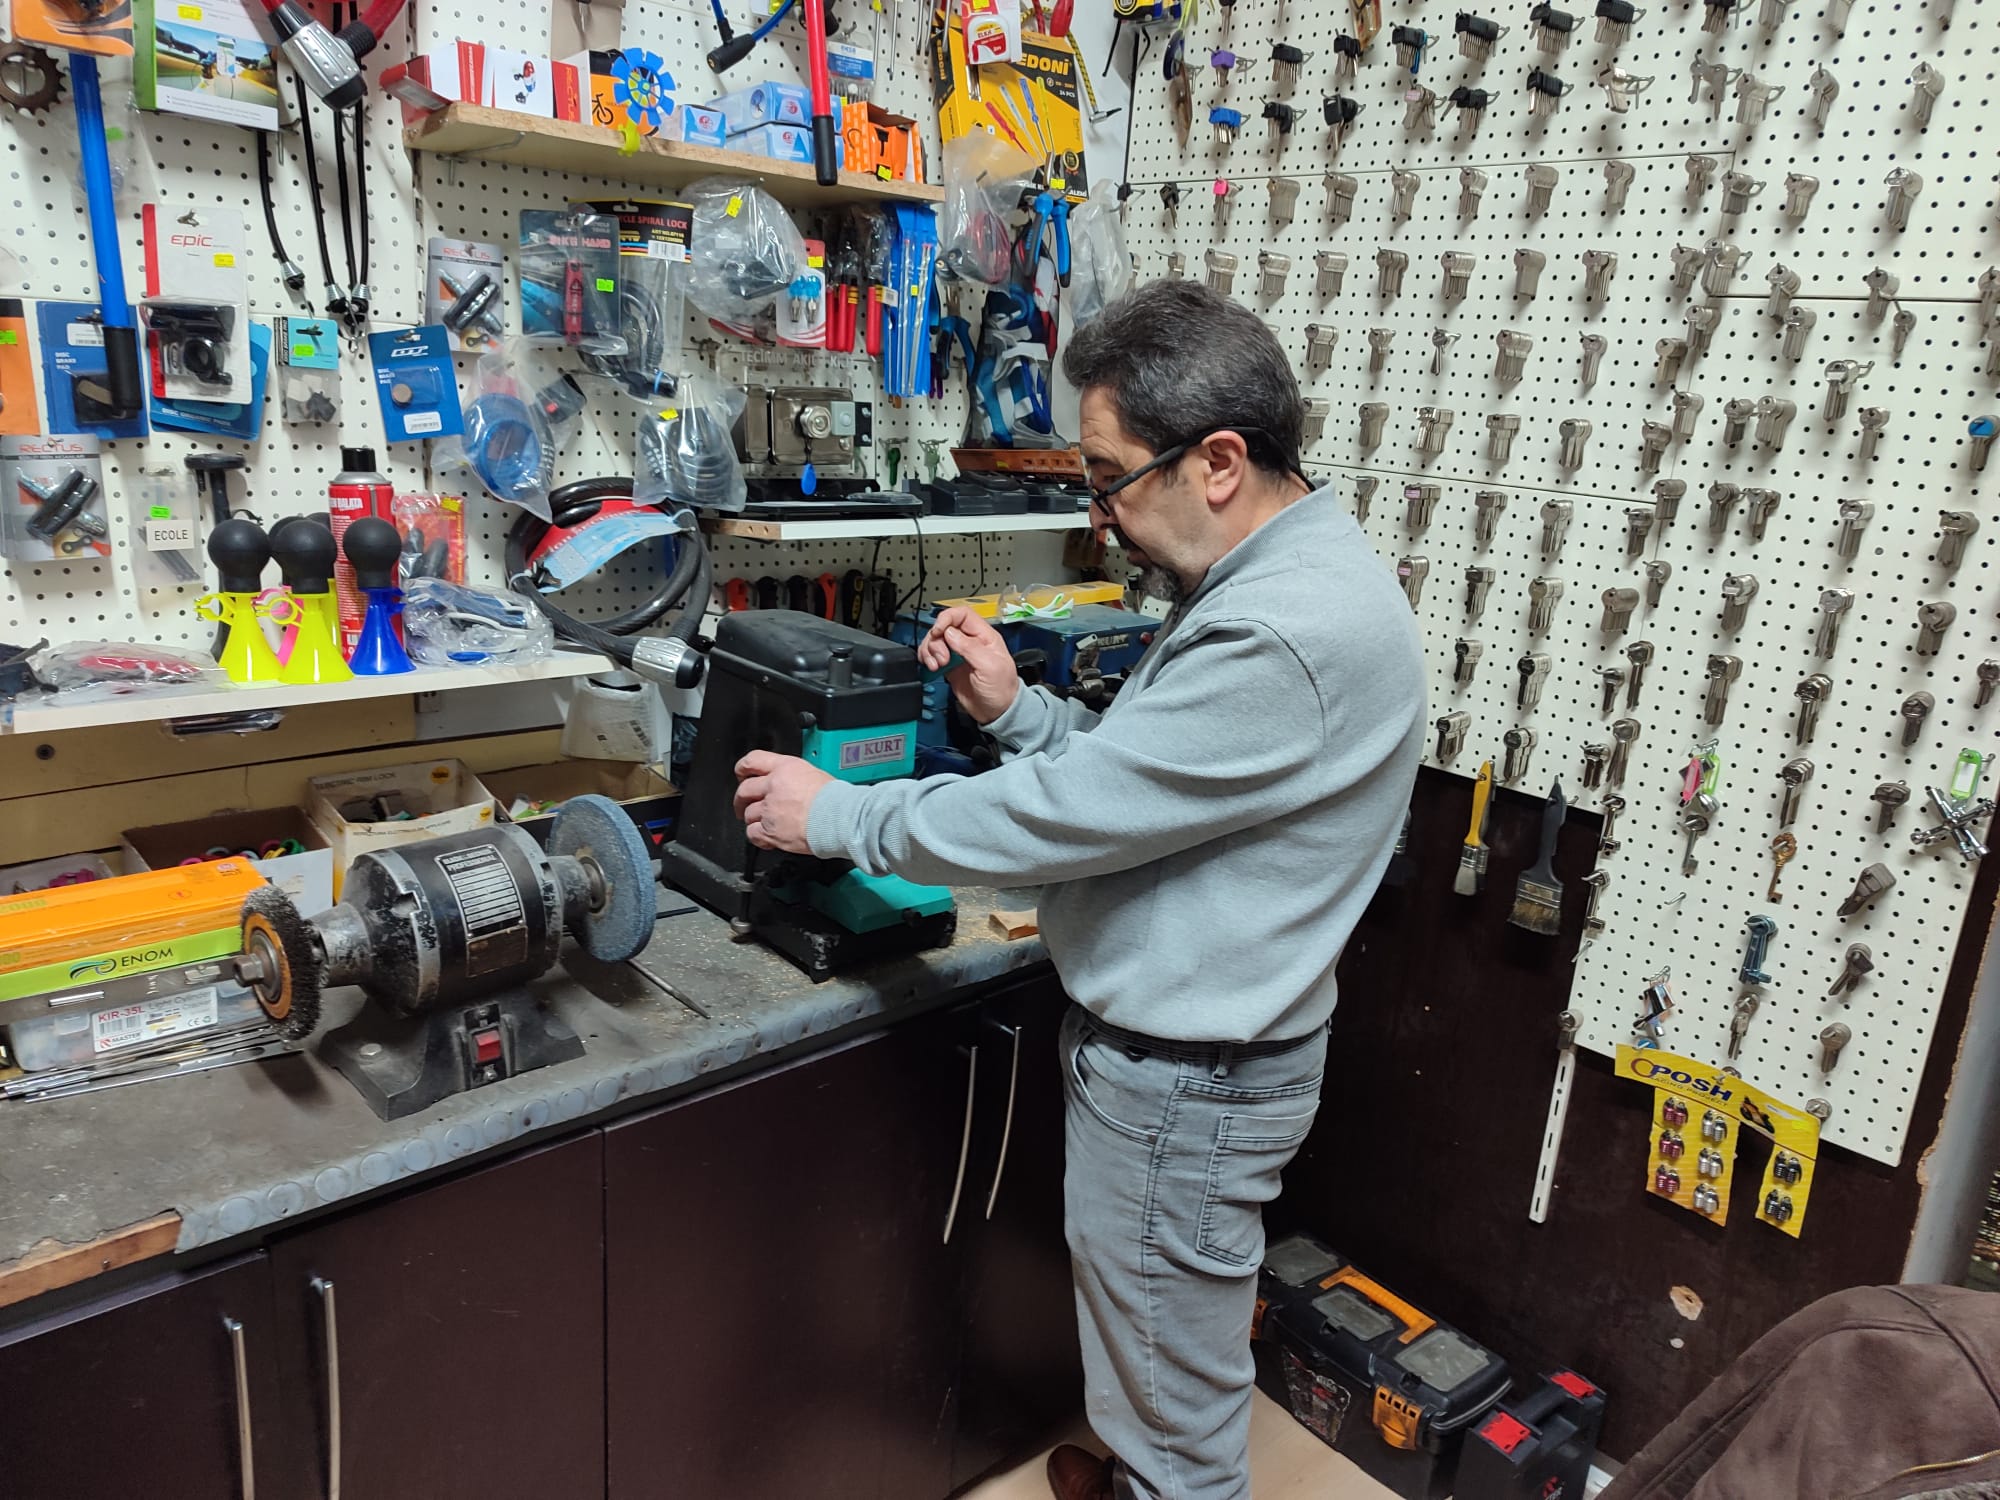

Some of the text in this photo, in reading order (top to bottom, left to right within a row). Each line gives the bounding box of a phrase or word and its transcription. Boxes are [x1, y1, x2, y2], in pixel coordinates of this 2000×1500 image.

[1015, 52, 1070, 76] EDONİ
[637, 215, 665, 226] SPIRAL
[667, 219, 688, 230] LOCK
[154, 529, 188, 541] ECOLE
[864, 738, 902, 756] KURT
[374, 771, 396, 781] LOCK
[121, 947, 174, 968] ENOM
[98, 1005, 147, 1023] KIR-35L
[1651, 1064, 1732, 1102] POSH
